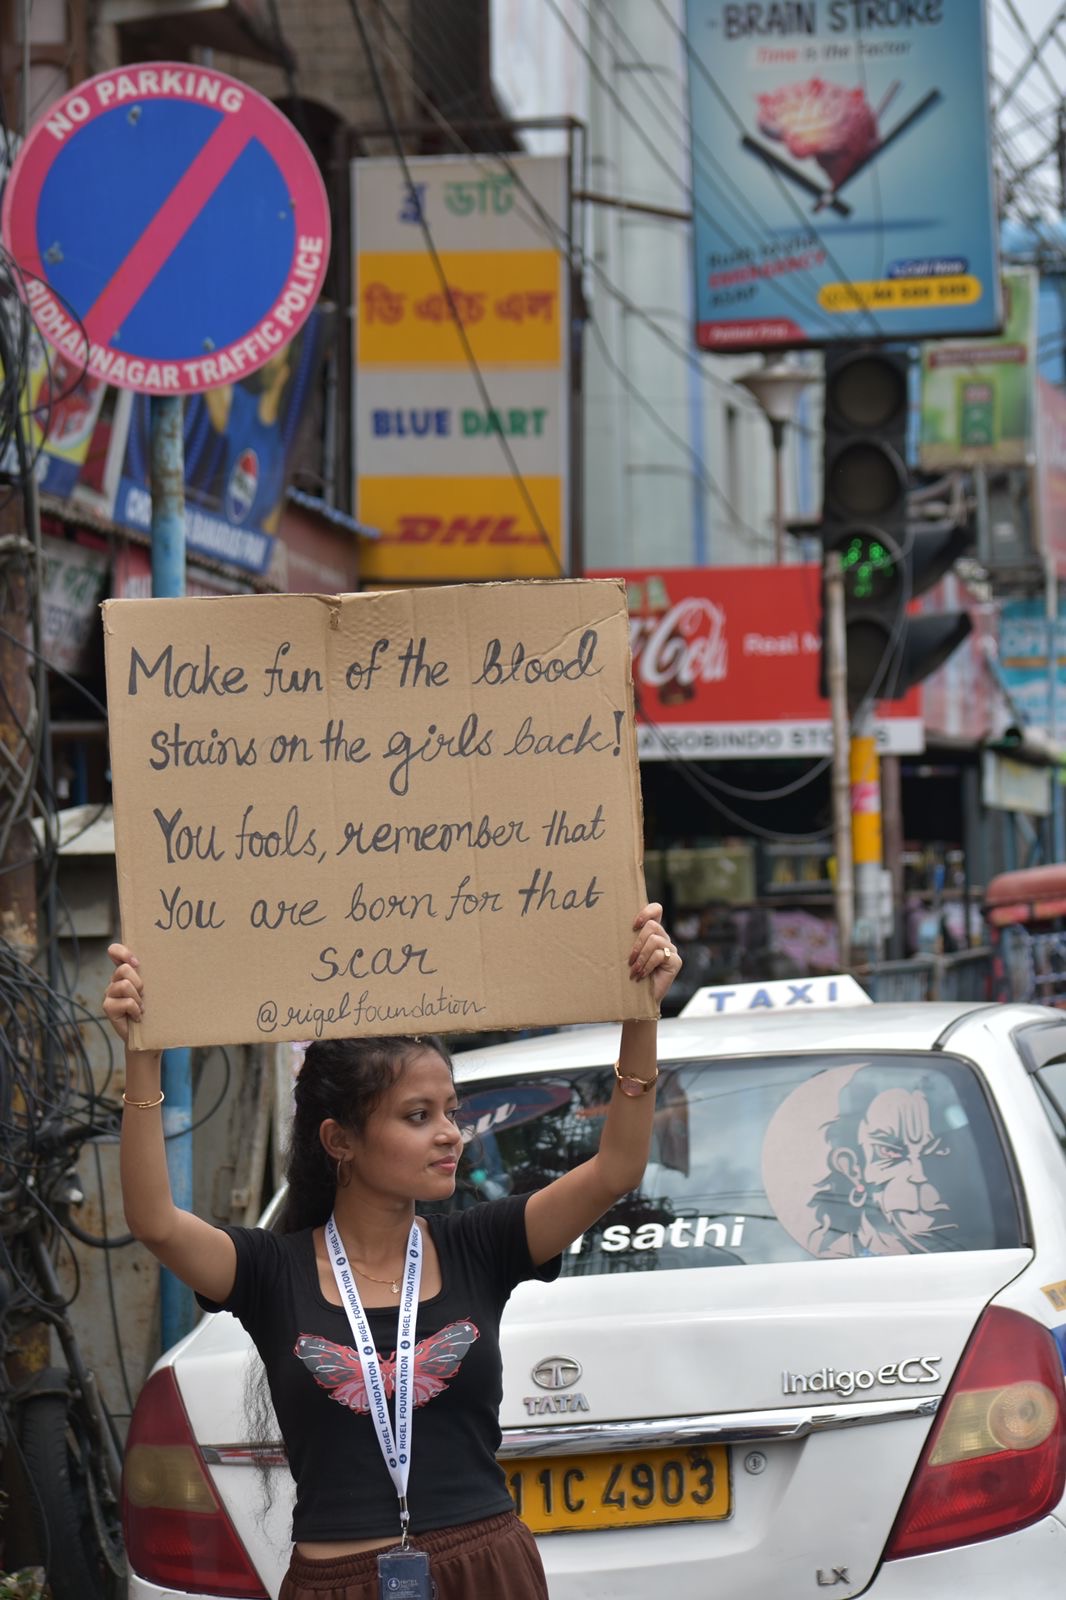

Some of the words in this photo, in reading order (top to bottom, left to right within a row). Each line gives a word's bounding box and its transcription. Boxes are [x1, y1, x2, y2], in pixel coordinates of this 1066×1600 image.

[723, 1, 816, 40] BRAIN
[45, 96, 90, 140] NO
[96, 70, 245, 113] PARKING
[184, 320, 283, 387] TRAFFIC
[274, 235, 323, 328] POLICE
[371, 408, 450, 437] BLUE
[461, 408, 547, 437] DART
[396, 515, 521, 545] DHL
[128, 645, 248, 698] Make
[264, 642, 323, 697] fun
[346, 638, 389, 690] of
[398, 637, 449, 687] the
[472, 628, 605, 685] blood
[149, 723, 257, 770] stains
[270, 735, 313, 764] on
[320, 720, 371, 764] the
[383, 713, 493, 796] girls
[503, 711, 626, 757] back!
[665, 729, 782, 751] GOBINDO
[789, 724, 889, 750] STOS
[153, 808, 225, 863] You
[235, 805, 327, 864] fools,
[336, 815, 530, 855] remember
[542, 805, 605, 846] that
[154, 886, 225, 931] You
[250, 899, 326, 929] are
[345, 883, 437, 921] born
[445, 876, 503, 921] for
[518, 868, 605, 917] that
[311, 943, 437, 983] scar
[708, 982, 837, 1012] TAXI
[601, 1216, 745, 1251] sathi
[340, 1269, 362, 1320] FOUNDATION
[404, 1261, 417, 1312] FOUNDATION
[357, 1320, 370, 1343] RIGEL
[402, 1314, 412, 1337] RIGEL
[367, 1361, 387, 1425] FOUNDATION
[399, 1355, 409, 1419] FOUNDATION
[523, 1393, 590, 1416] TATA
[381, 1426, 393, 1454] RIGEL
[602, 1458, 715, 1511] 4903
[816, 1564, 851, 1587] LX
